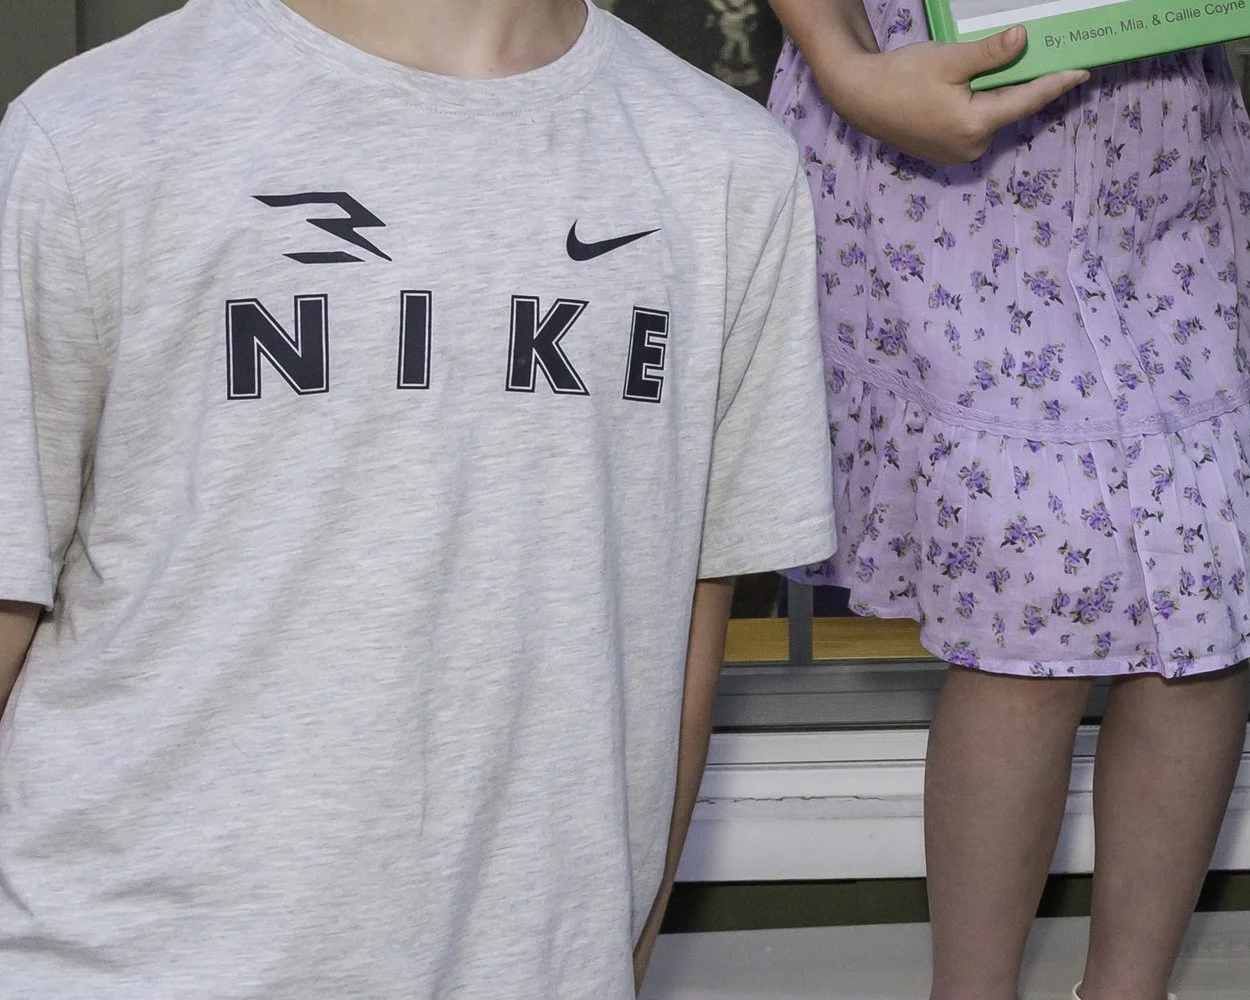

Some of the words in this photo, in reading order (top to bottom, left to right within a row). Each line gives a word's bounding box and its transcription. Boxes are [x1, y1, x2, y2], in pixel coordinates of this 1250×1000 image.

[1044, 34, 1066, 48] By:
[1069, 24, 1117, 42] Mason,
[1120, 18, 1148, 32] Mia,
[1152, 14, 1161, 26] &
[1165, 8, 1201, 23] Callie
[1204, 0, 1246, 15] Coyne
[225, 290, 670, 403] NIKE
